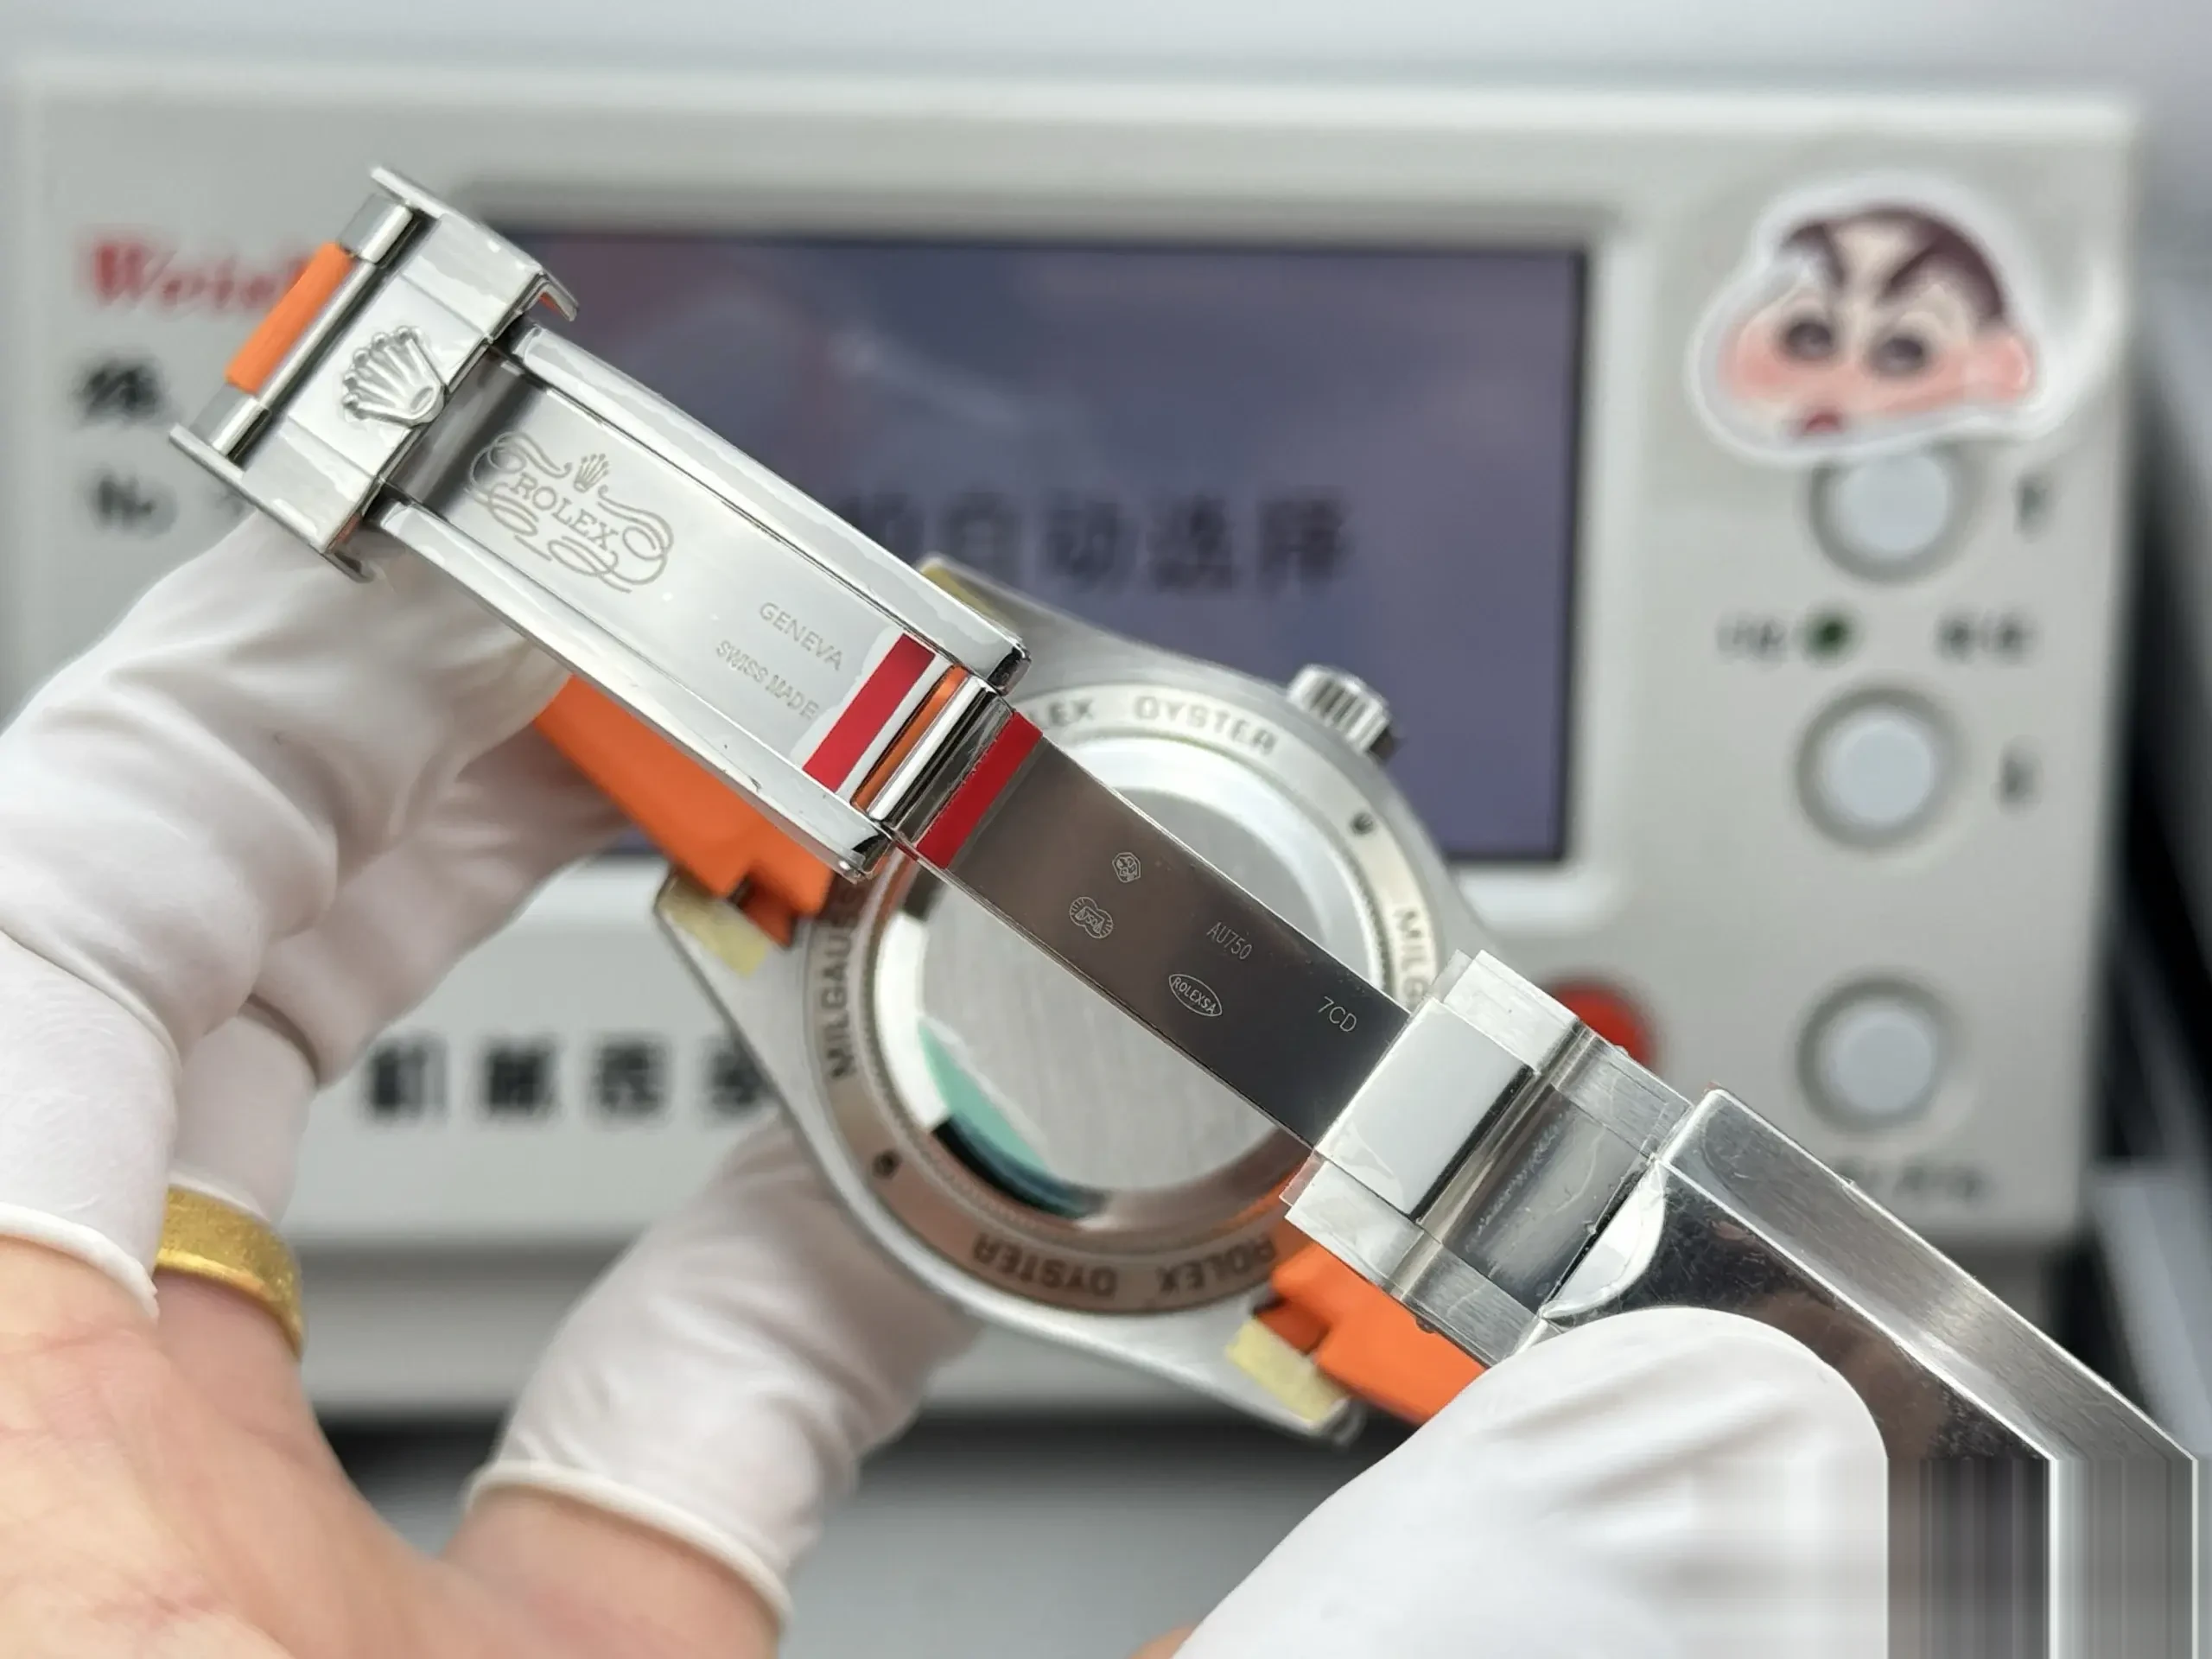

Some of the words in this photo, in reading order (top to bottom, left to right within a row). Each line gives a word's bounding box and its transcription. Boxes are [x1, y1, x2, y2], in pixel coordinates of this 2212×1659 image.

[510, 472, 619, 551] ROLEX
[759, 601, 842, 671] GENEVA
[715, 639, 769, 683] SWISS
[765, 674, 820, 721] MADE
[1135, 695, 1279, 754] OYSTER
[1206, 922, 1253, 960] AU750
[1318, 995, 1357, 1032] 7CD
[971, 1231, 1119, 1298] OYSTER
[1155, 1236, 1277, 1295] ROLEX
